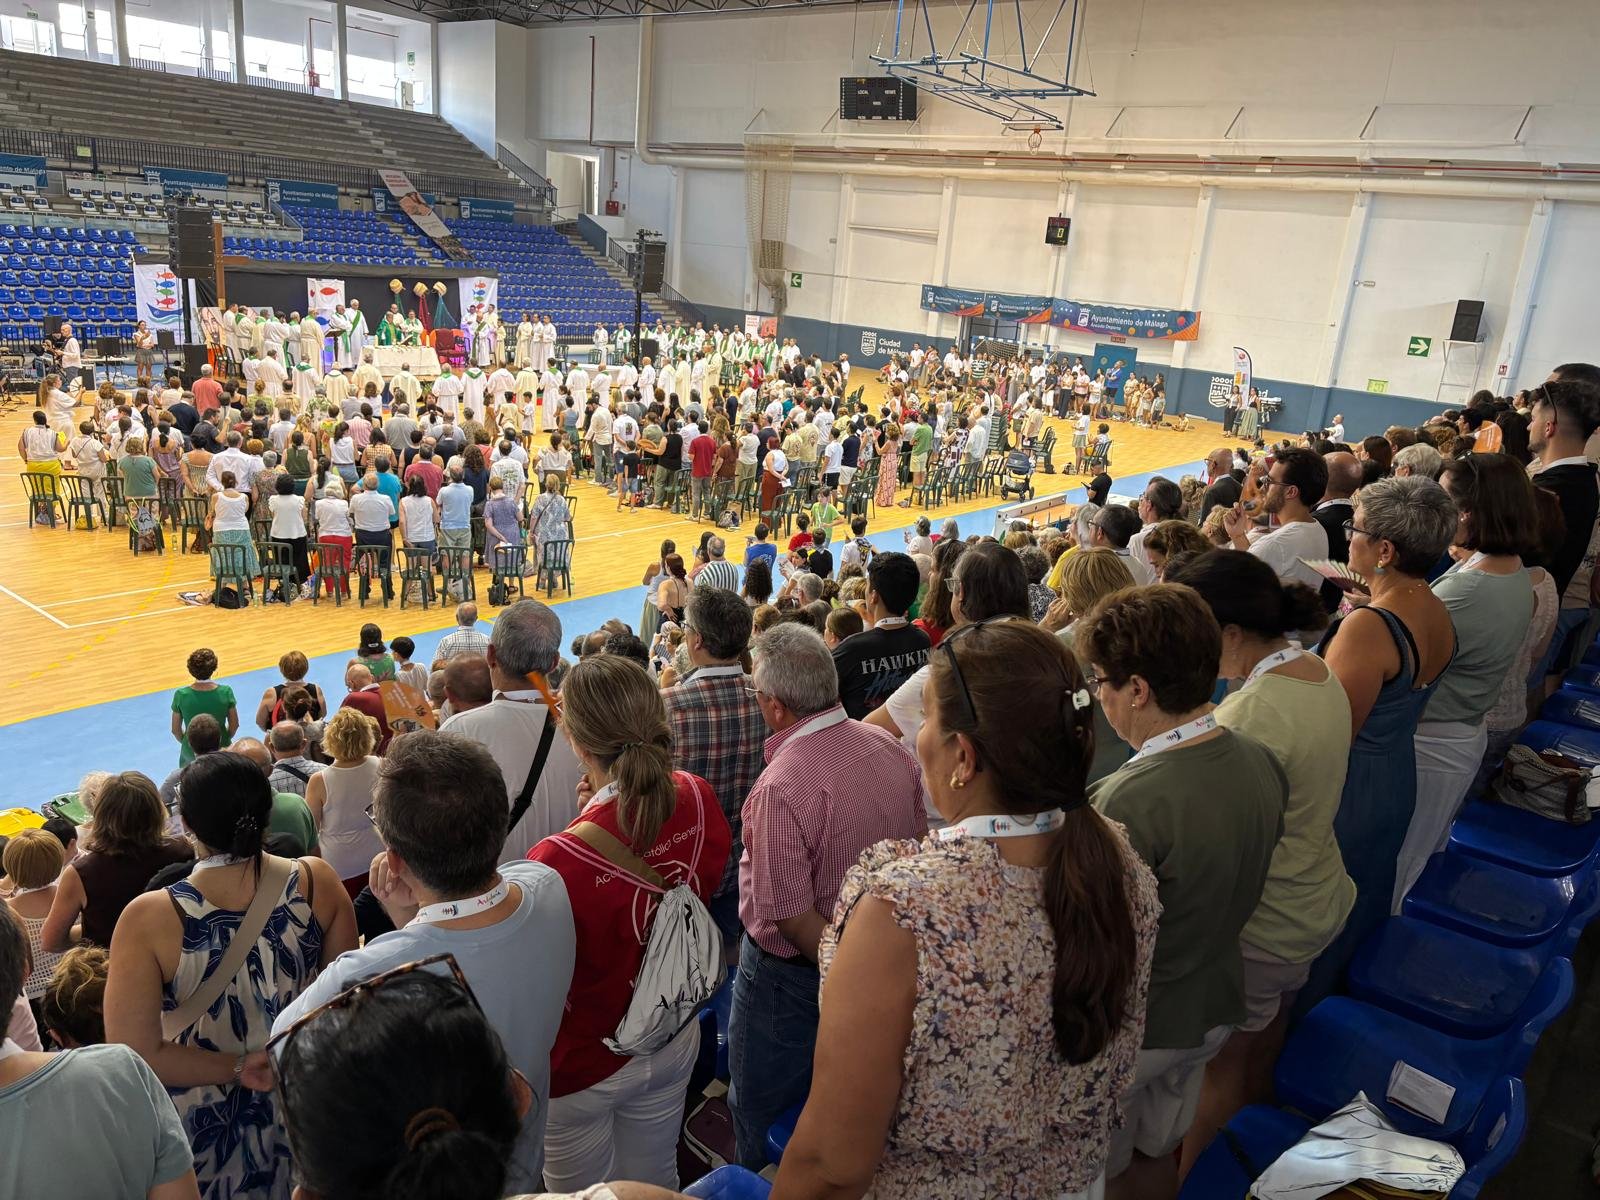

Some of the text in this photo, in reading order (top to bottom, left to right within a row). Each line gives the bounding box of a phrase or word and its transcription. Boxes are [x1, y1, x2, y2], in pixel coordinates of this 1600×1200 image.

[1091, 314, 1168, 328] Ayuntamiento de Málaga
[879, 338, 901, 347] Ciudad
